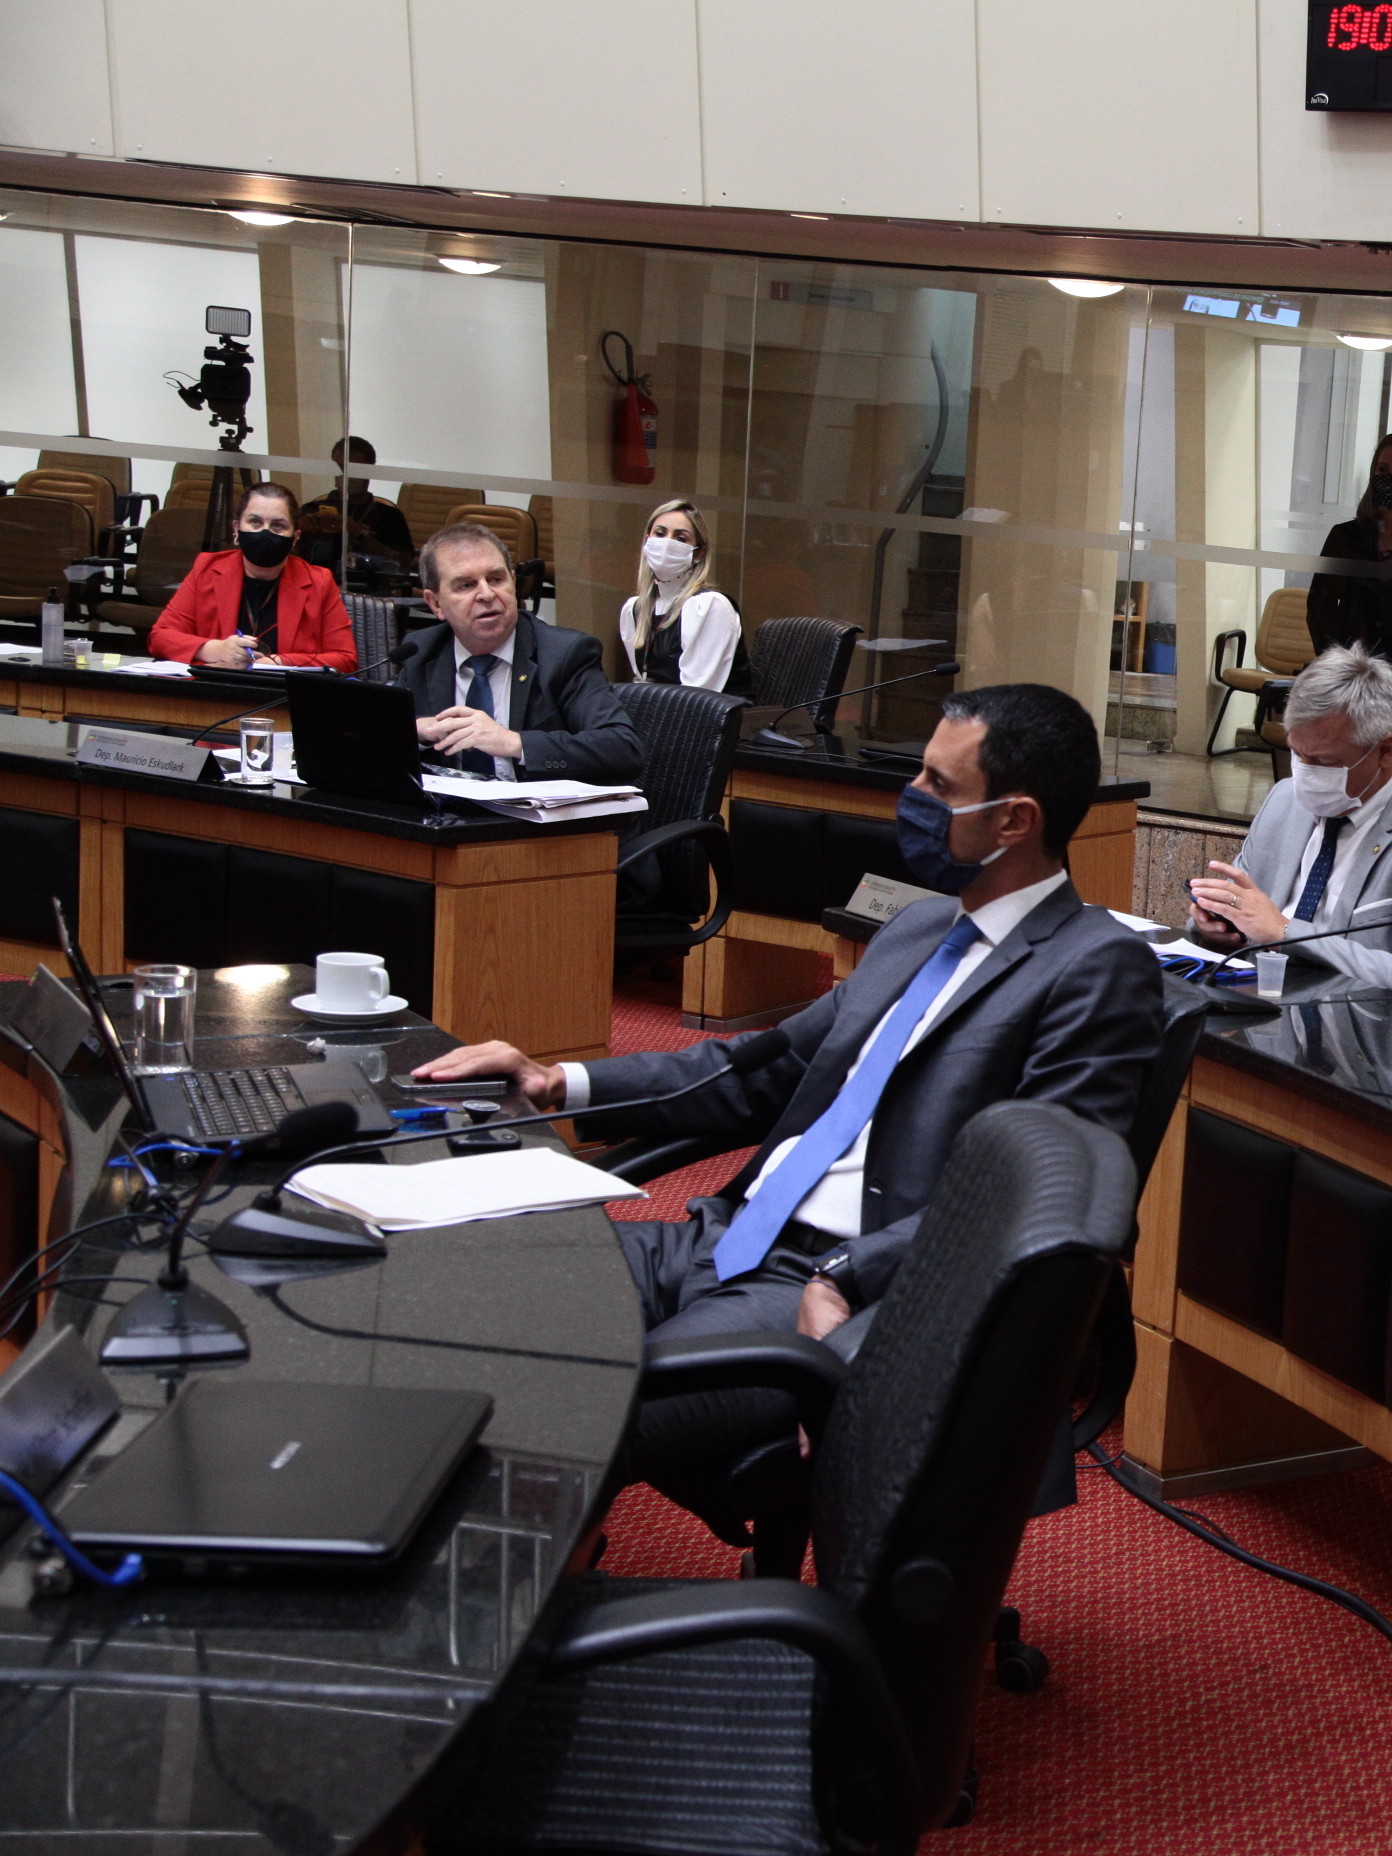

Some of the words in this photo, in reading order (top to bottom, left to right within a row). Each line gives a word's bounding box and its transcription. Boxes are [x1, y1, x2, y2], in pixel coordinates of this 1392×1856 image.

[95, 748, 112, 761] Dep.
[148, 757, 185, 773] Eskudlark
[868, 898, 883, 914] Dep.
